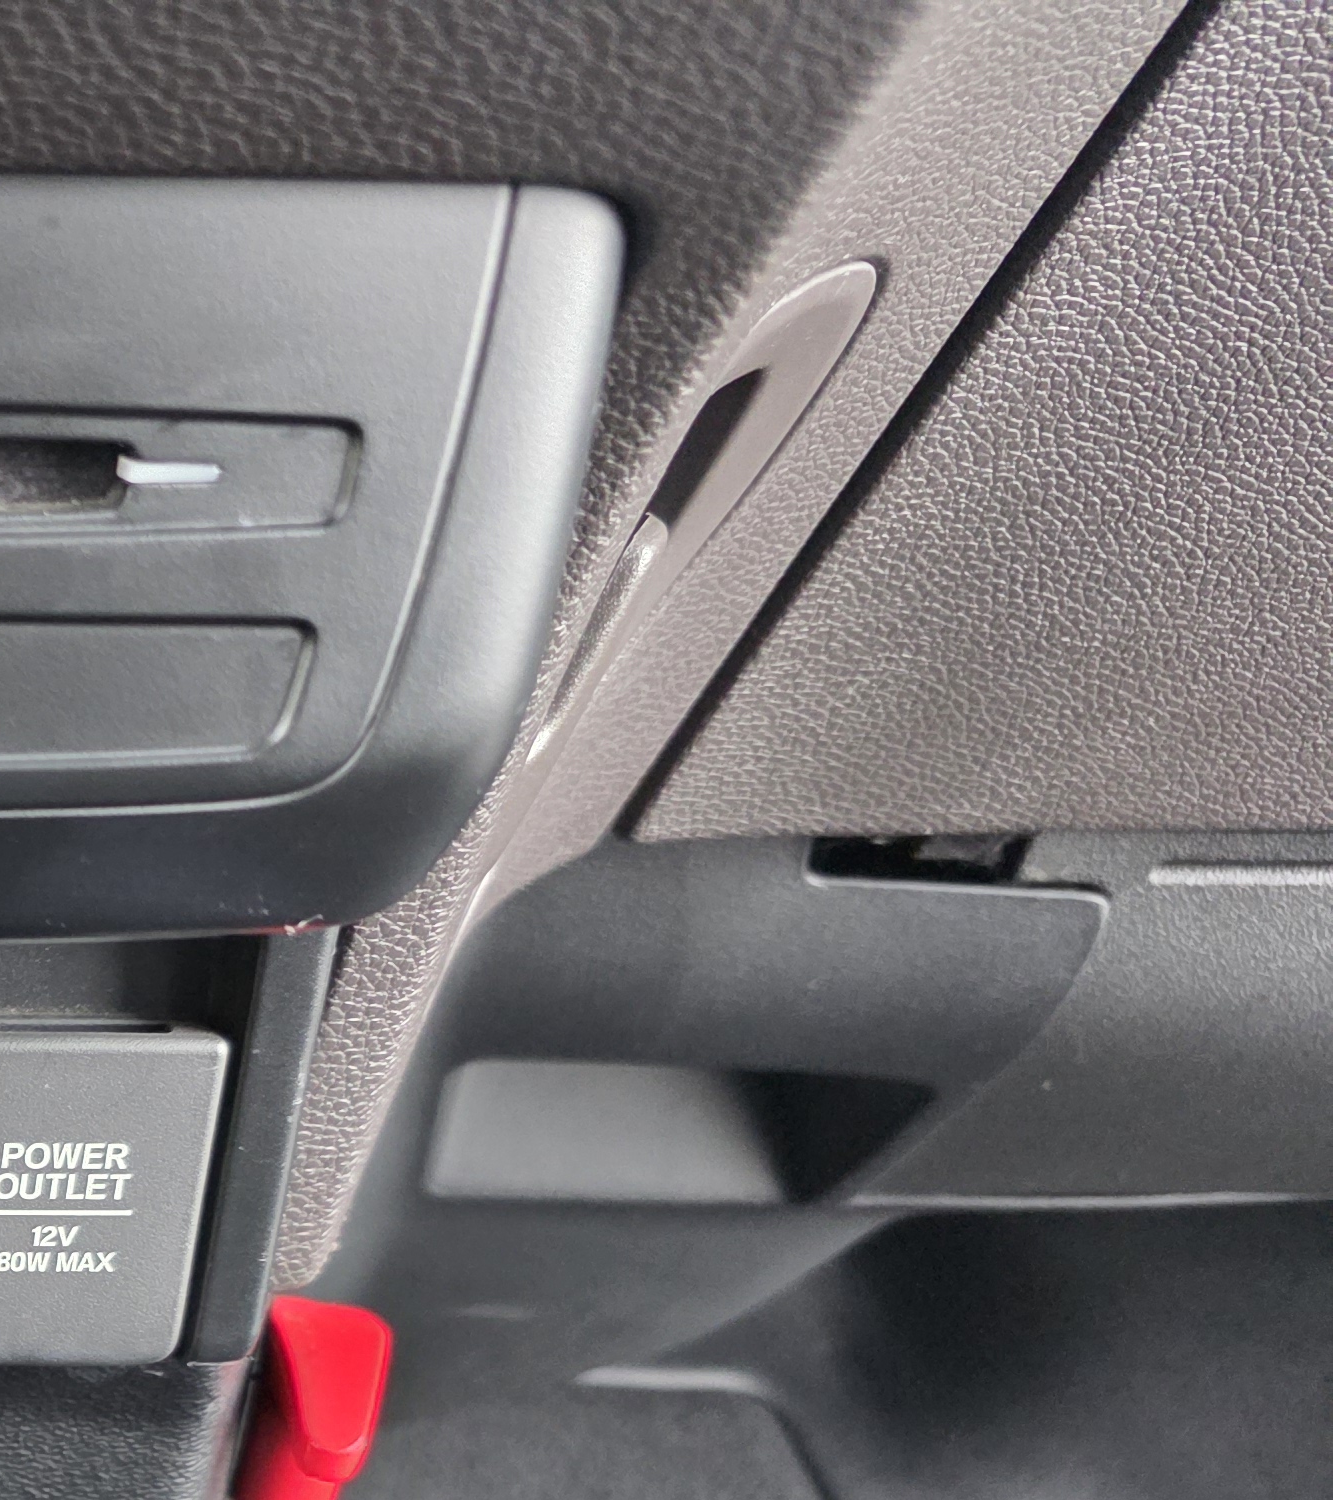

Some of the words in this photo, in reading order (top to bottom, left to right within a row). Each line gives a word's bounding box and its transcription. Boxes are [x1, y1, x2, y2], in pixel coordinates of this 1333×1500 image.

[0, 1142, 130, 1170] POWER
[31, 1225, 81, 1247] 12V
[55, 1251, 118, 1273] MAX
